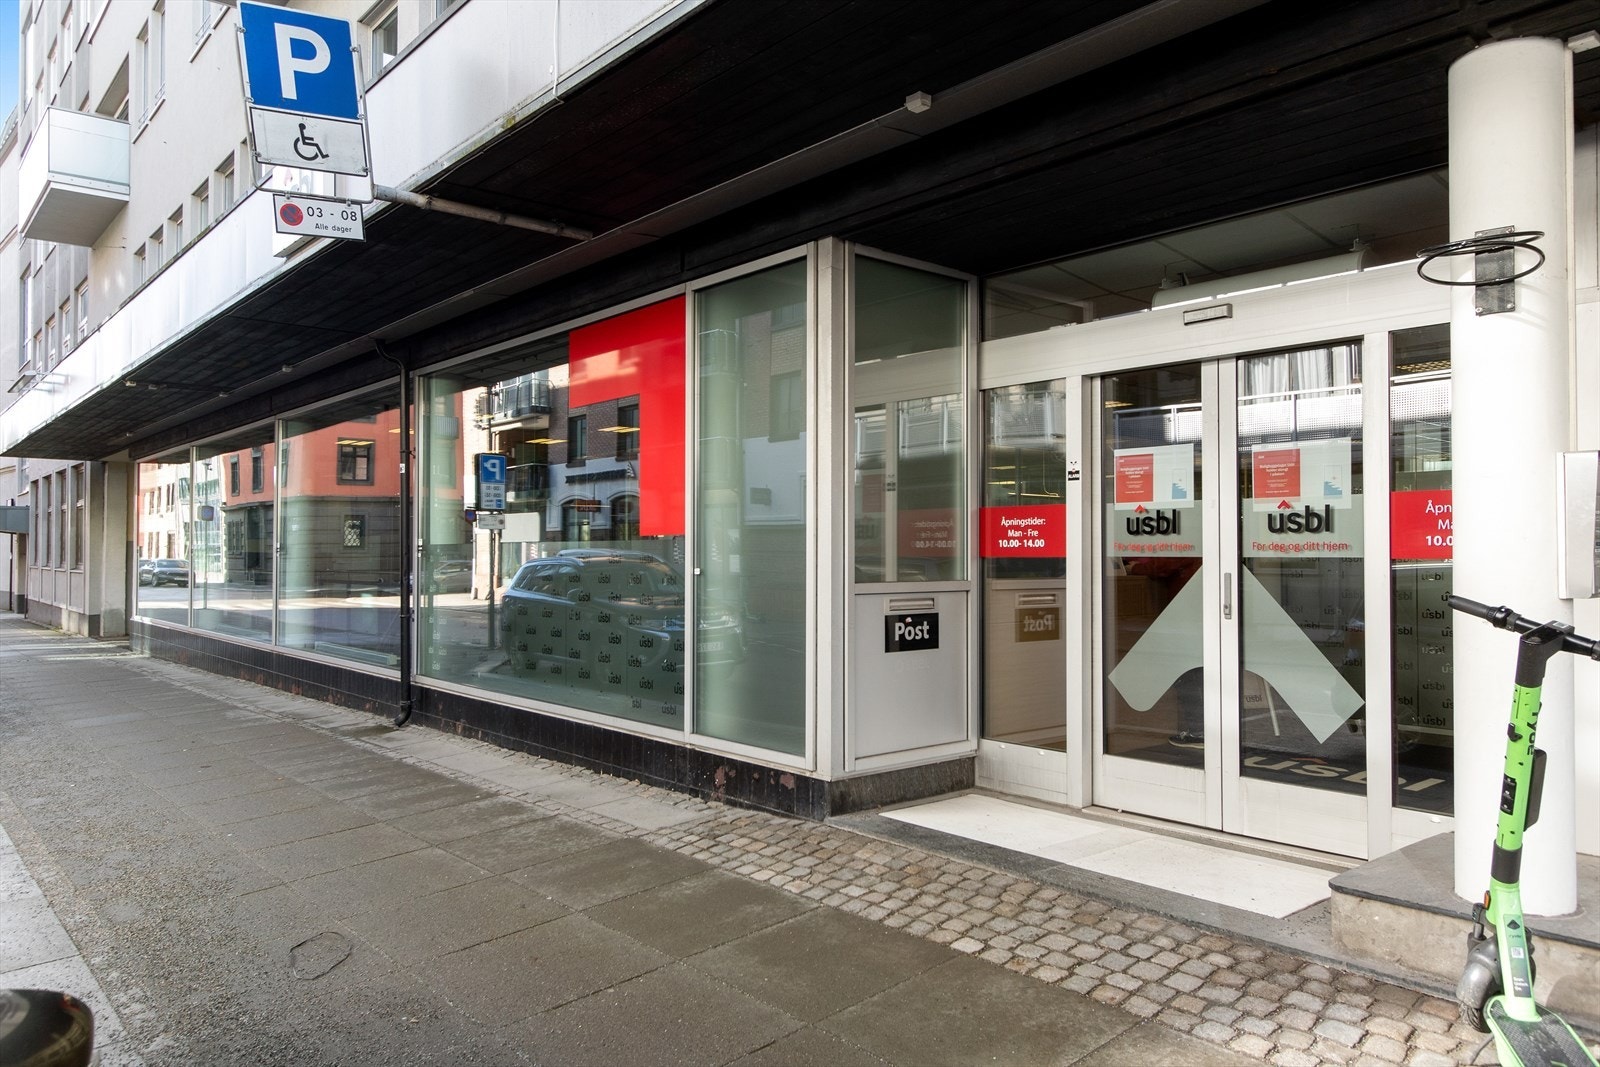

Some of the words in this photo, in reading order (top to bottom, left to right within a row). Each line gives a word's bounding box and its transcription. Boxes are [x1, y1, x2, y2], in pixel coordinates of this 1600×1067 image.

[274, 22, 331, 100] P
[306, 206, 323, 218] 03
[341, 210, 358, 222] 08
[315, 223, 329, 231] Alle
[331, 225, 353, 234] dager
[1425, 500, 1452, 515] Åpn
[1001, 516, 1046, 527] Åpningstider:
[1008, 529, 1023, 537] Man
[1027, 529, 1039, 537] Fre
[1023, 539, 1045, 548] 14.00
[1425, 535, 1453, 546] 10.0
[1252, 541, 1266, 551] For
[1268, 541, 1286, 552] deg
[1288, 543, 1300, 553] og
[1303, 541, 1321, 550] ditt
[1323, 541, 1348, 552] hjem
[894, 621, 930, 641] Post
[1397, 626, 1413, 636] sbl
[1398, 696, 1413, 706] sbl
